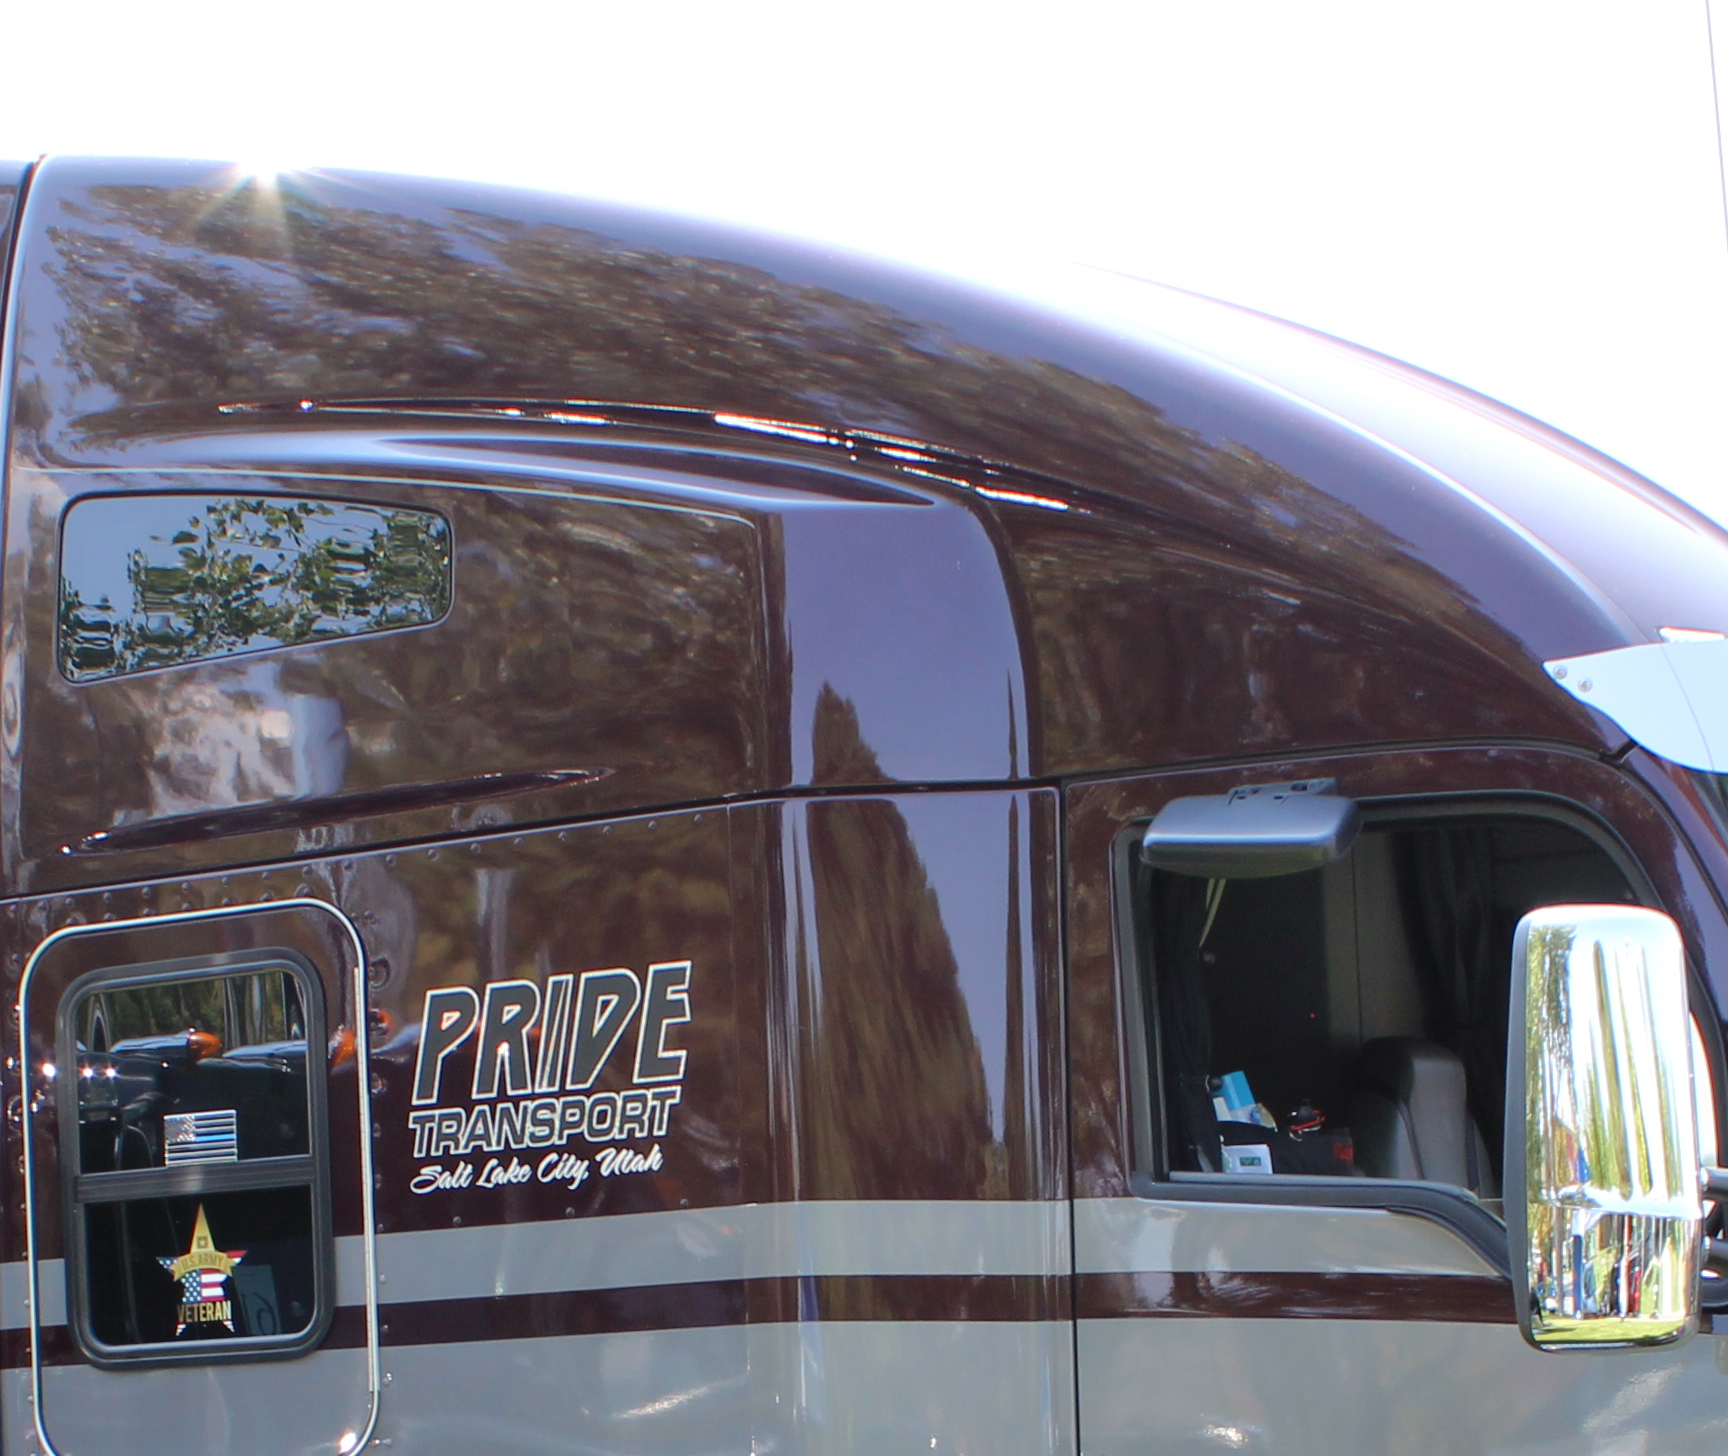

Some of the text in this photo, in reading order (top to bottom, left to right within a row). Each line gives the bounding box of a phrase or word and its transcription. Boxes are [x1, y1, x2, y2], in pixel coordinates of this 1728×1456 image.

[411, 960, 692, 1105] PRIDE
[408, 1085, 682, 1158] TRANSPORT
[410, 1143, 664, 1194] Salt Lake City, Utah
[198, 1255, 224, 1267] ARMY
[176, 1300, 232, 1323] VETERAN
